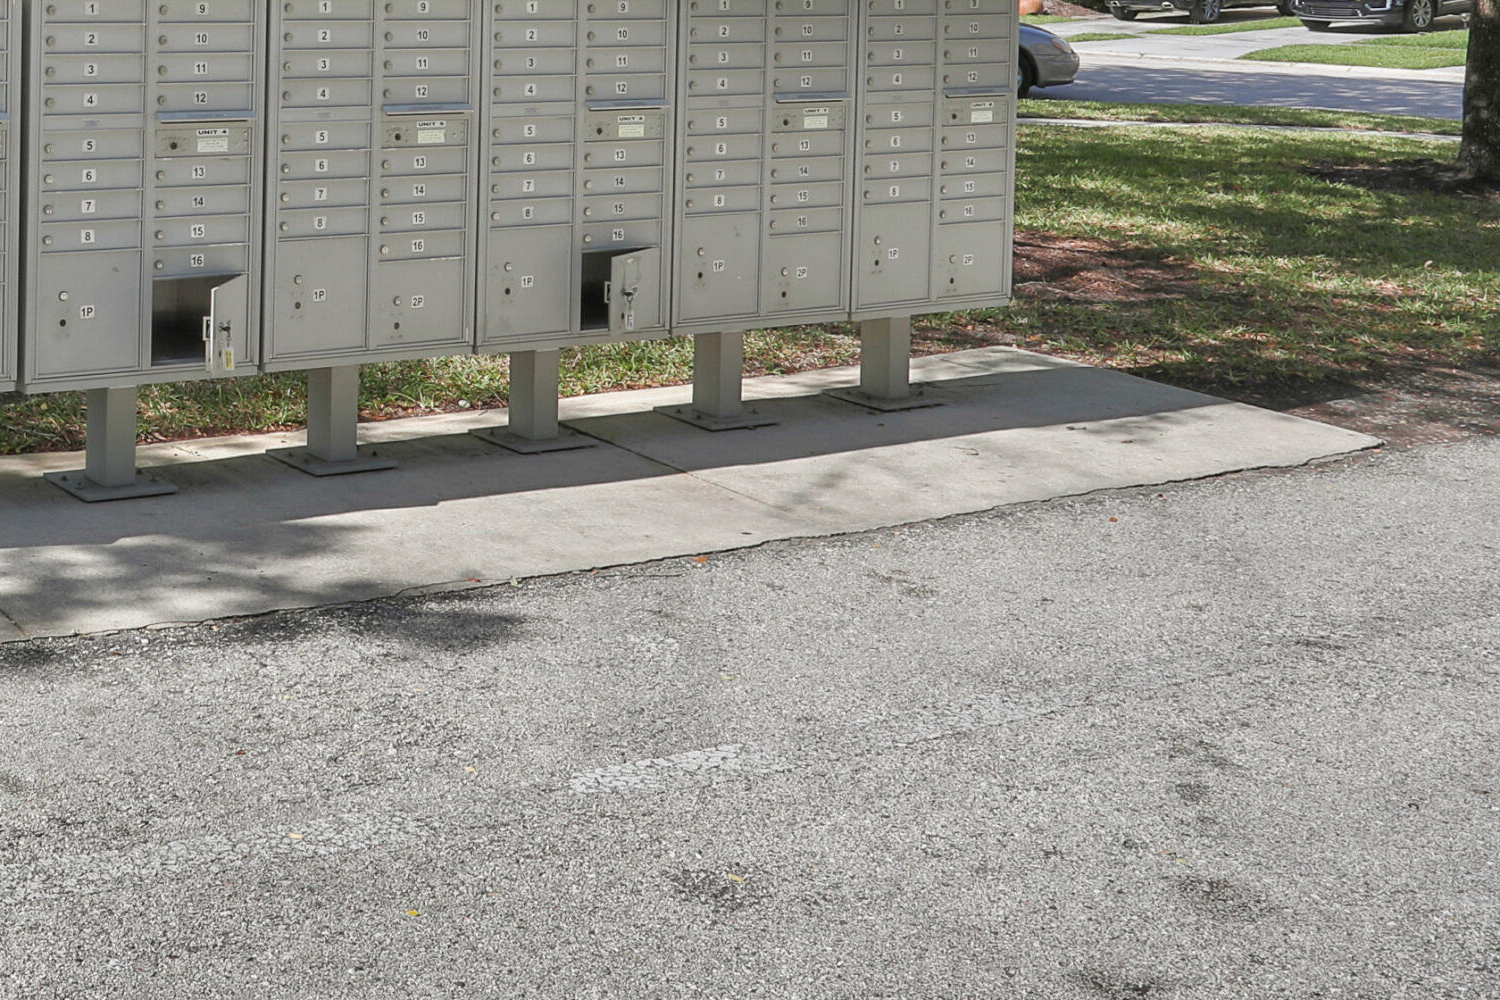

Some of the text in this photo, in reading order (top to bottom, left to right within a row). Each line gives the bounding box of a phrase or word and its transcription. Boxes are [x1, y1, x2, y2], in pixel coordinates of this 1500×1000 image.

[90, 3, 94, 14] 1
[199, 4, 206, 14] 9
[323, 2, 327, 12] 1
[420, 2, 426, 12] 9
[530, 3, 534, 12] 1
[620, 2, 626, 12] 9
[722, 0, 727, 9] 1
[805, 0, 811, 9] 9
[897, 0, 901, 8] 1
[972, 0, 977, 8] 9
[722, 26, 727, 36] 2
[803, 26, 812, 34] 10
[896, 24, 901, 34] 2
[970, 24, 978, 32] 10
[88, 34, 95, 44] 2
[196, 33, 207, 44] 10
[322, 31, 328, 41] 2
[418, 30, 428, 40] 10
[529, 30, 534, 40] 2
[618, 30, 628, 38] 10
[721, 52, 726, 62] 3
[803, 52, 811, 60] 11
[896, 50, 900, 58] 3
[970, 48, 977, 56] 11
[321, 60, 327, 70] 3
[418, 58, 427, 68] 11
[528, 58, 534, 67] 3
[618, 57, 626, 65] 11
[88, 64, 94, 75] 3
[196, 63, 206, 73] 11
[802, 76, 811, 86] 12
[894, 75, 900, 83] 4
[968, 72, 977, 81] 12
[617, 83, 626, 92] 12
[720, 79, 725, 88] 4
[320, 89, 326, 98] 4
[417, 86, 427, 96] 12
[527, 85, 534, 94] 4
[87, 95, 94, 105] 4
[196, 93, 206, 103] 12
[894, 112, 899, 121] 5
[719, 118, 724, 127] 5
[527, 126, 533, 136] 5
[319, 132, 325, 142] 5
[893, 137, 898, 146] 6
[967, 134, 975, 142] 13
[86, 140, 93, 150] 5
[718, 144, 724, 153] 6
[800, 140, 809, 150] 13
[526, 154, 532, 163] 6
[616, 150, 625, 160] 13
[318, 160, 325, 170] 6
[415, 157, 425, 167] 13
[966, 158, 974, 166] 14
[194, 167, 204, 177] 13
[717, 170, 723, 179] 7
[800, 166, 808, 174] 14
[86, 170, 92, 181] 6
[526, 181, 532, 190] 7
[615, 177, 624, 185] 14
[415, 186, 424, 194] 14
[966, 182, 974, 191] 15
[318, 189, 324, 199] 7
[799, 191, 808, 200] 15
[85, 201, 92, 211] 7
[194, 196, 204, 206] 14
[614, 203, 624, 213] 15
[965, 206, 972, 215] 16
[317, 218, 323, 228] 8
[414, 213, 424, 223] 15
[798, 217, 806, 226] 16
[192, 226, 204, 236] 15
[613, 230, 623, 239] 16
[84, 231, 91, 242] 8
[413, 241, 423, 250] 16
[889, 249, 898, 258] 1P
[192, 255, 203, 266] 16
[964, 256, 972, 264] 2P
[714, 261, 723, 270] 1P
[523, 277, 532, 286] 1P
[314, 290, 325, 300] 1P
[412, 297, 423, 307] 2P
[82, 307, 93, 317] 1P
